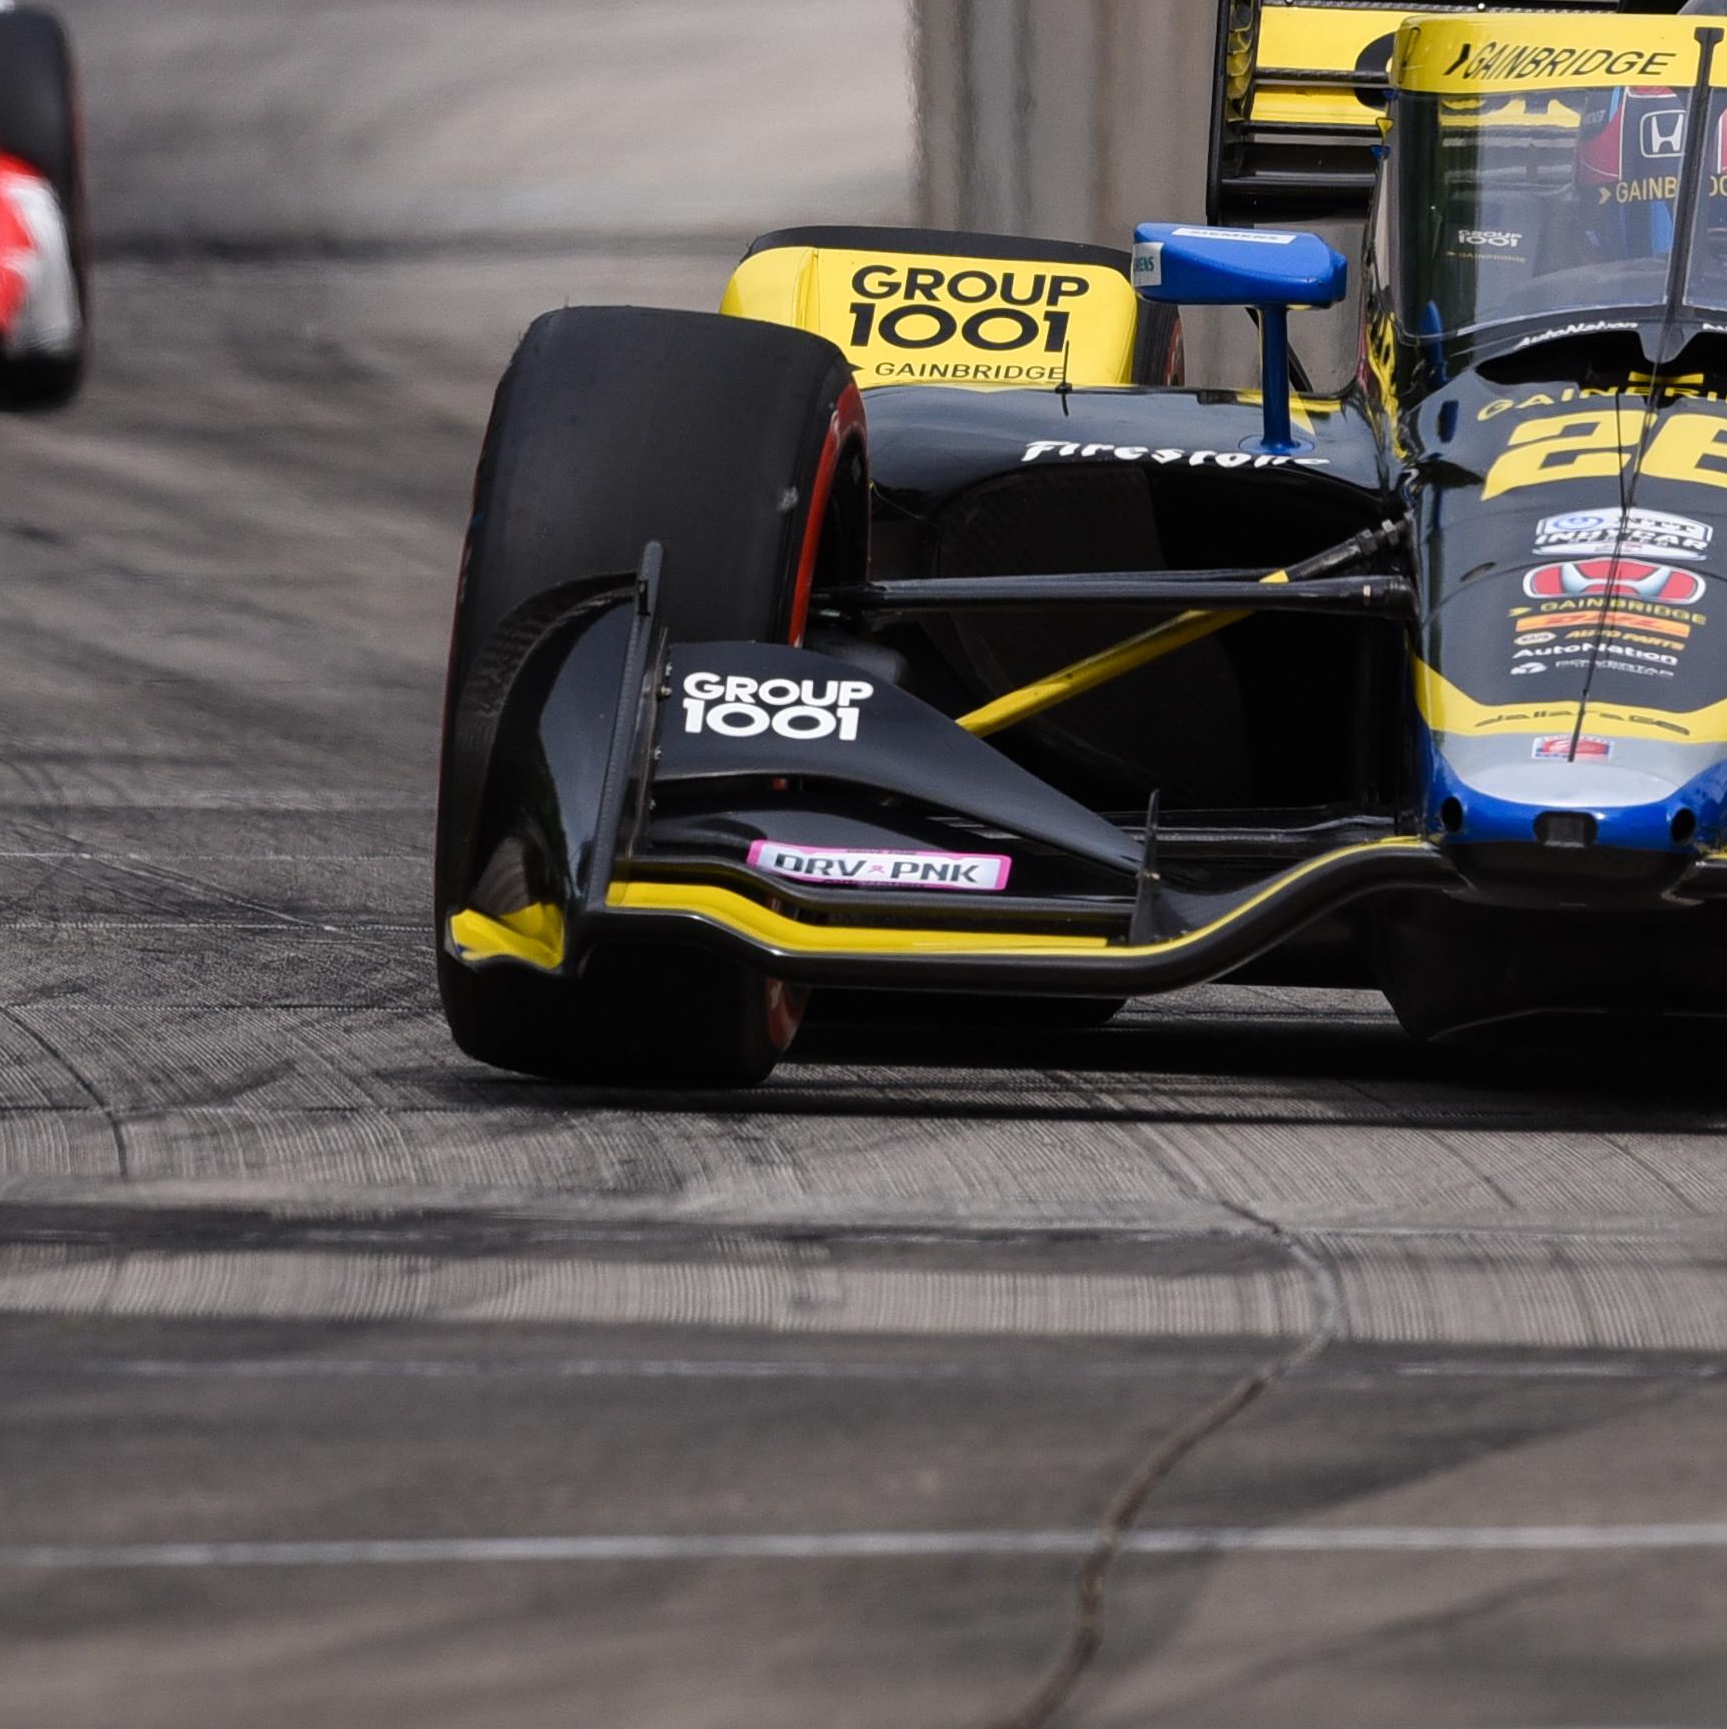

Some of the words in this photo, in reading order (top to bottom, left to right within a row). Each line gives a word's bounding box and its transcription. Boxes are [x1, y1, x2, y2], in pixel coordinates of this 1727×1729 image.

[1462, 40, 1677, 81] GAINBRIDGE
[851, 265, 1090, 307] GROUP
[848, 302, 1070, 352] 1001
[1515, 320, 1639, 348] AutoNation
[874, 362, 1066, 381] GAINBRIDGE
[1021, 440, 1330, 468] Firestone
[1534, 528, 1709, 551] INDYCAR
[1541, 597, 1707, 626] GAINBRIDGE
[1512, 642, 1679, 667] AutoNation
[1564, 629, 1622, 640] AUTO
[1622, 632, 1685, 651] PARTS
[683, 672, 874, 707] GROUP
[683, 698, 859, 741] 1001
[774, 853, 867, 877] DRV
[890, 862, 979, 883] PNK
